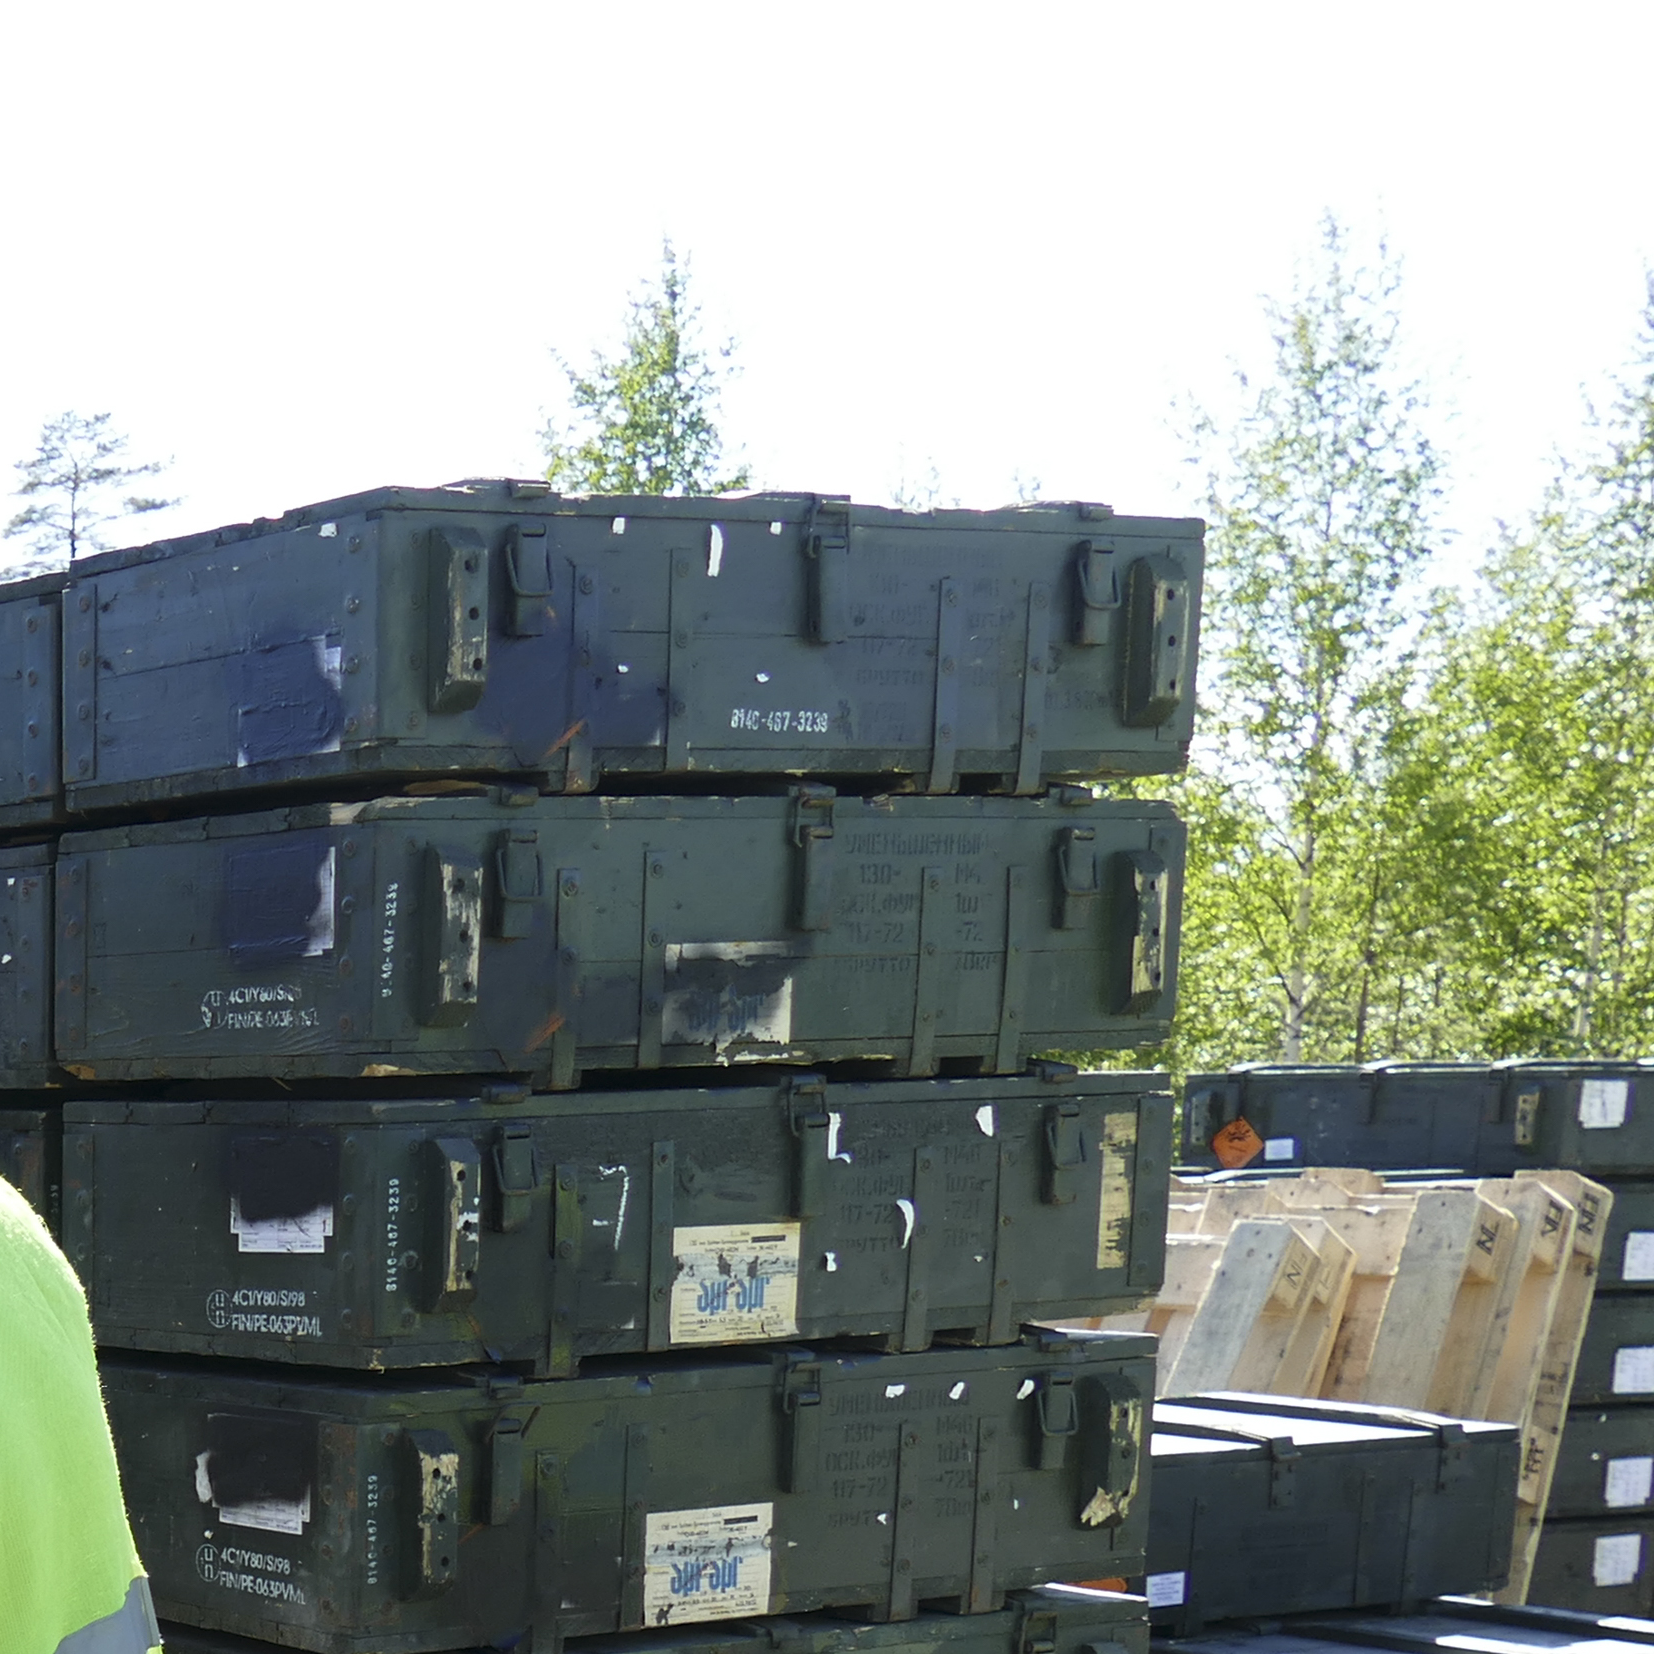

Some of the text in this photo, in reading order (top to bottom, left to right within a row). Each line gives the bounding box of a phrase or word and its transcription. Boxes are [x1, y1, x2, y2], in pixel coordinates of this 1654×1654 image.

[385, 1178, 400, 1292] 8140-467-3239
[231, 1289, 306, 1307] 4C1/Y80/S/98
[231, 1314, 323, 1337] FIN/PE-063PVML
[220, 1547, 291, 1575] 4C1/Y80/S/98
[219, 1571, 306, 1605] FIN/PE-063PVML
